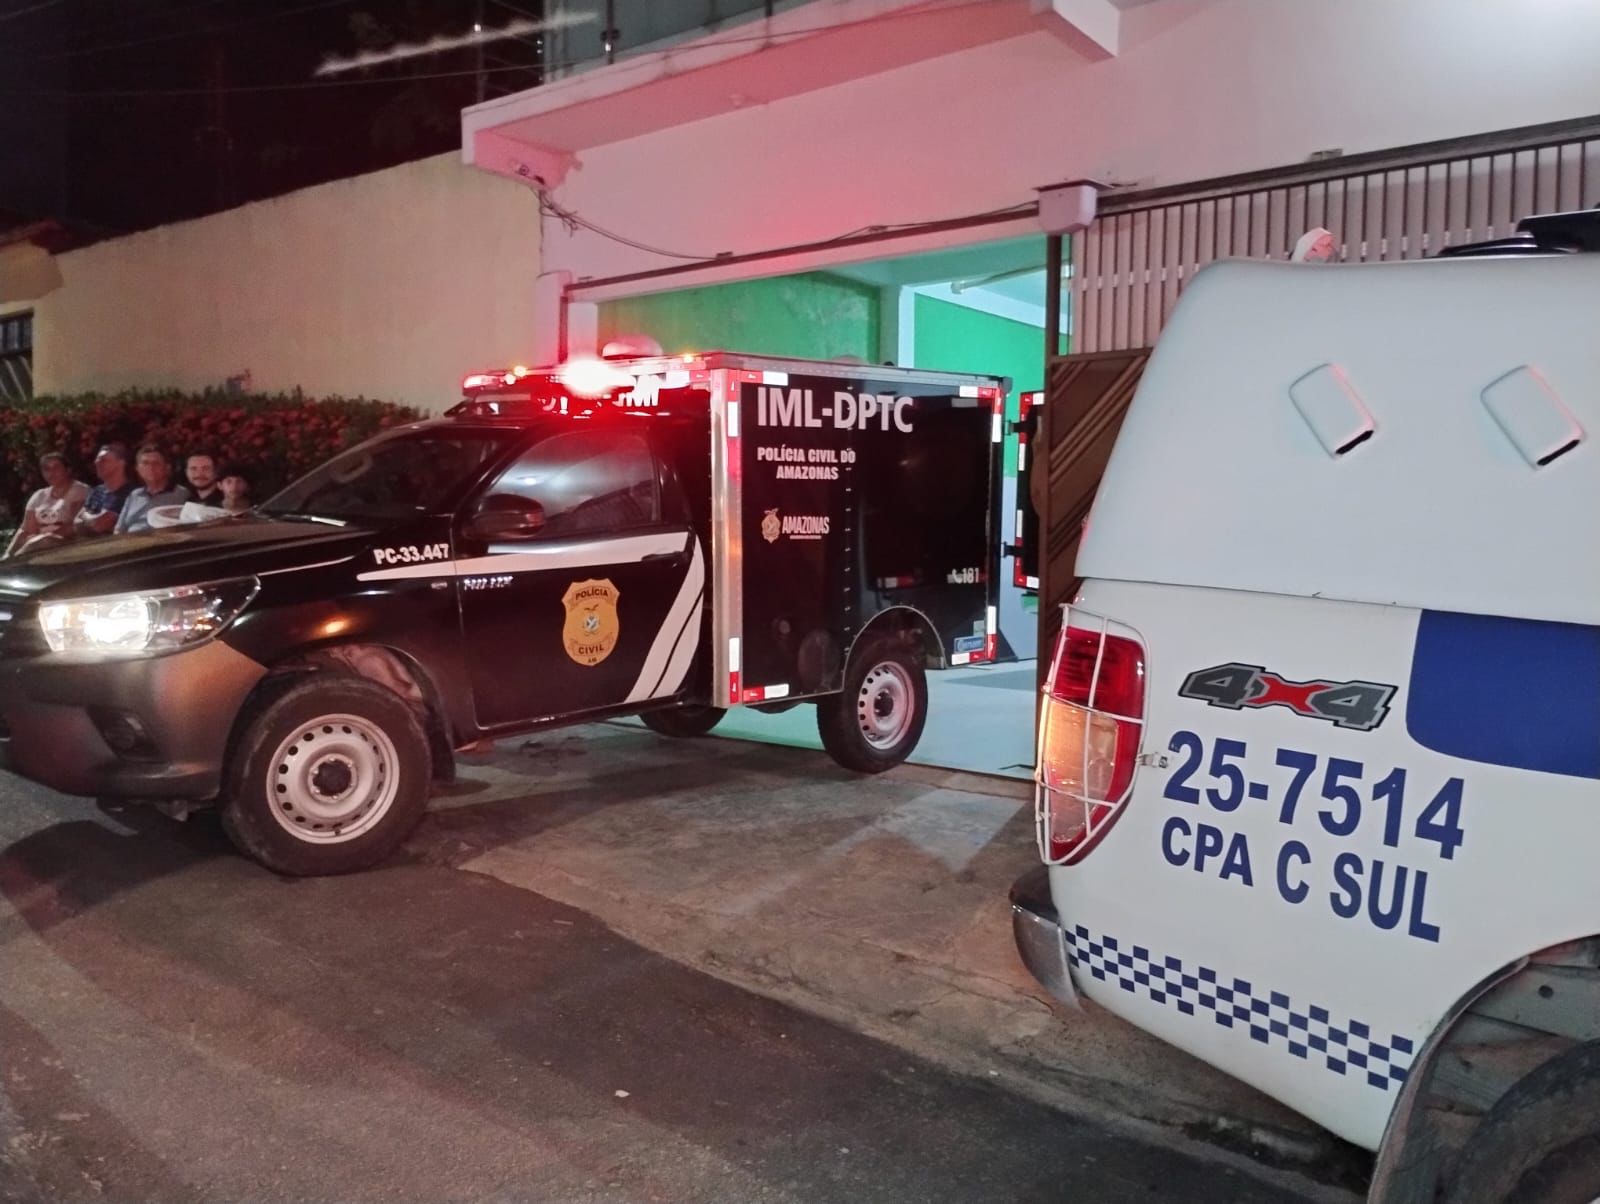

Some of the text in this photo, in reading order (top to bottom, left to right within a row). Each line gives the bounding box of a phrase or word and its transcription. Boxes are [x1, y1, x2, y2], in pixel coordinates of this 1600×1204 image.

[757, 386, 914, 433] IML-DPTC
[757, 444, 806, 463] POLÍCIA
[808, 448, 839, 464] CIVIL
[776, 465, 840, 480] AMAZONAS
[781, 515, 830, 535] AMAZONAS
[373, 543, 449, 565] PC-33.447
[961, 567, 980, 584] 181
[575, 588, 609, 600] POLÍCIA
[578, 645, 604, 655] CIVIL
[1163, 730, 1465, 860] 25-7514
[1161, 816, 1440, 943] CPA C SUL
